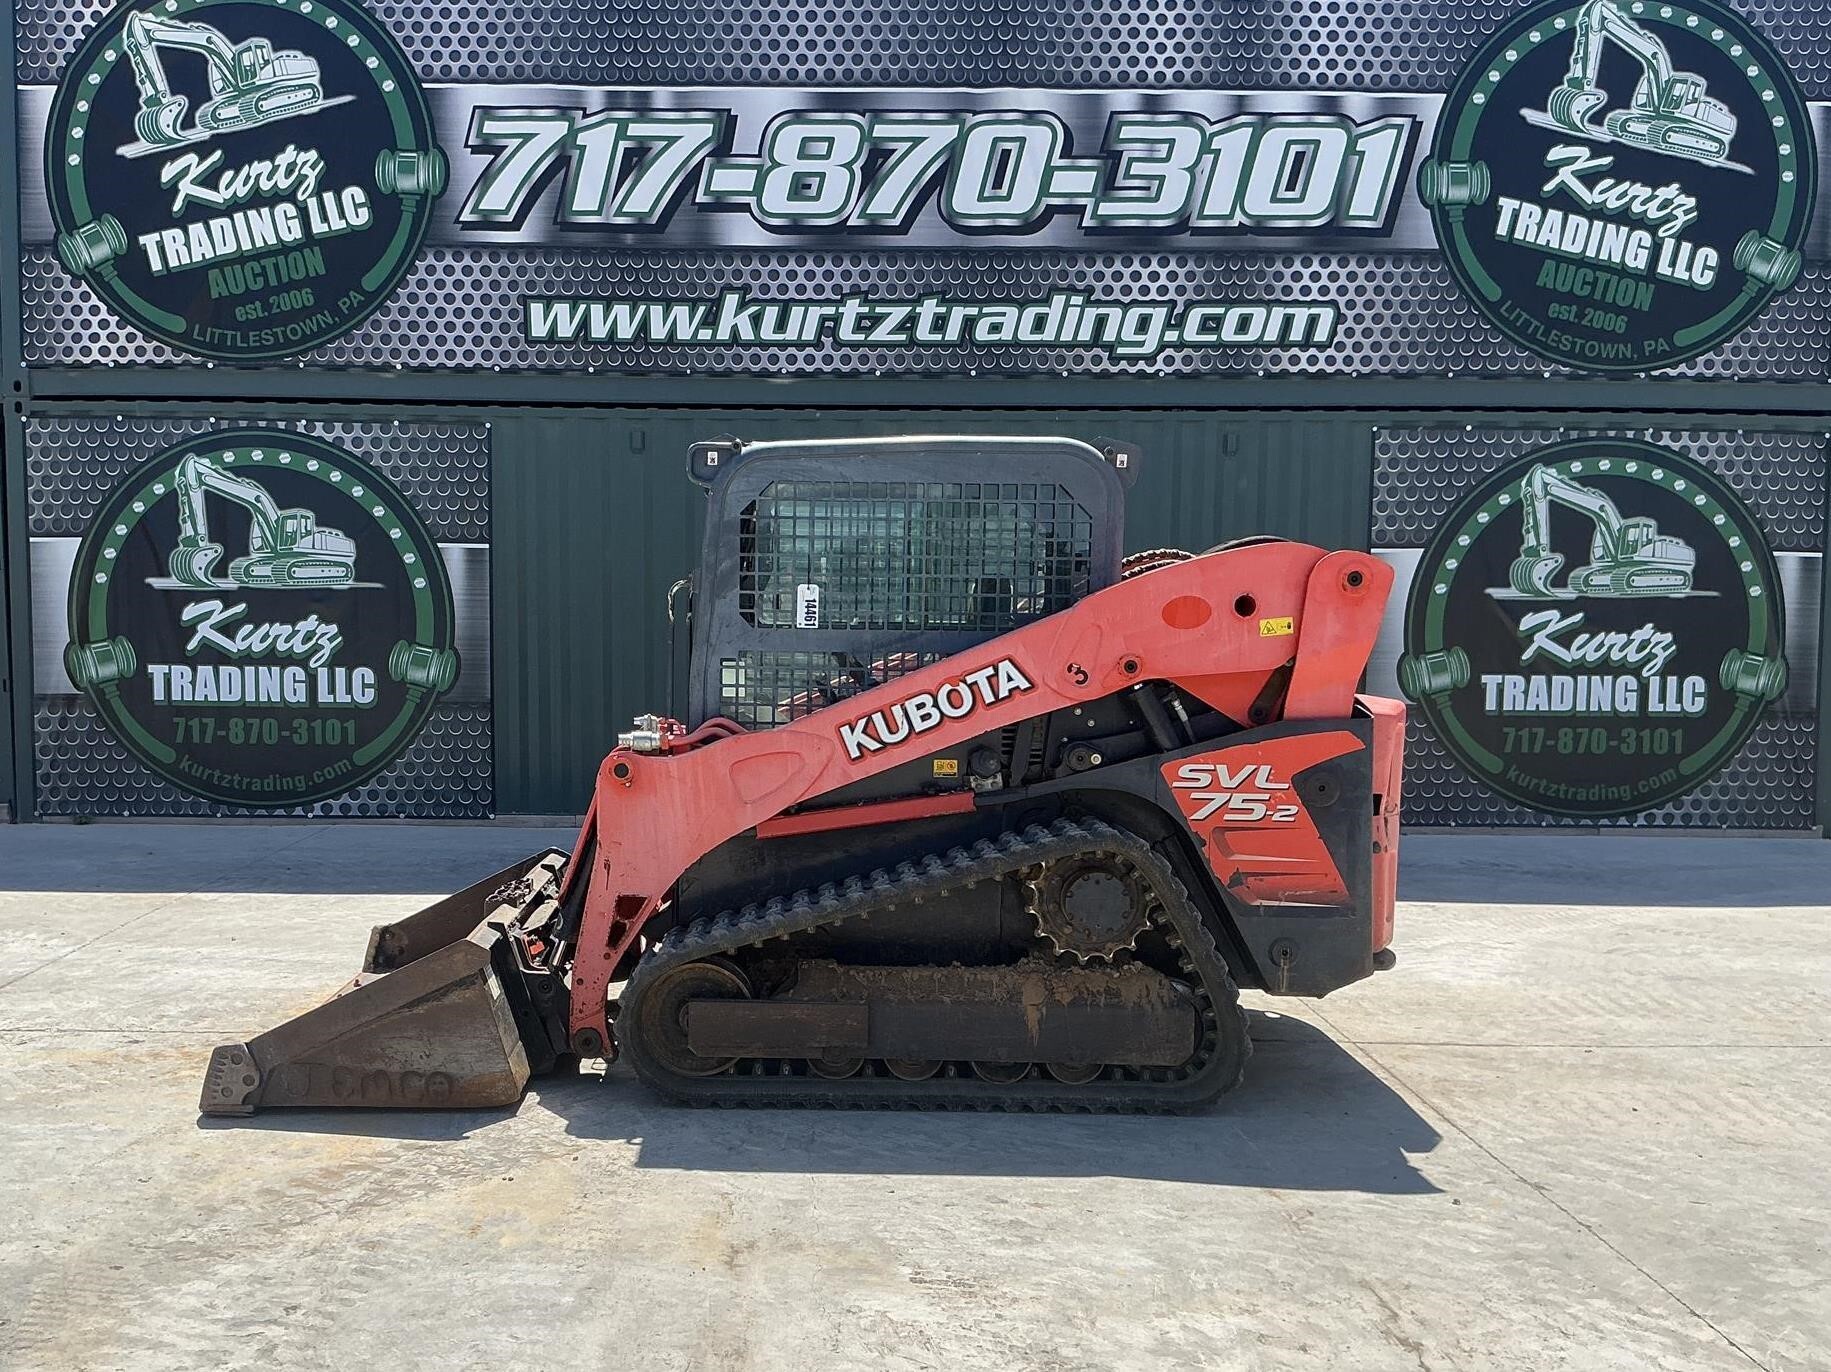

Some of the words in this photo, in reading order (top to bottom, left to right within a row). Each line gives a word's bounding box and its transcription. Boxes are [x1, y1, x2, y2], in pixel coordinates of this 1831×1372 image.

[162, 145, 324, 213] Kurtz
[466, 113, 1408, 222] 717-870-3101
[1541, 145, 1698, 237] Kurtz
[139, 205, 301, 272] TRADING
[306, 187, 371, 235] LLC
[1496, 197, 1651, 269] TRADING
[1659, 239, 1719, 285] LLC
[209, 252, 326, 299] AUCTION
[1537, 260, 1655, 311] AUCTION
[194, 313, 340, 346] LITTLESTOWN,
[339, 291, 366, 318] PA
[235, 302, 268, 322] est.
[271, 288, 315, 316] 2006
[526, 293, 1338, 355] www.kurtztrading.com
[1548, 303, 1578, 324] est.
[1581, 306, 1628, 333] 2006
[1500, 300, 1637, 360] LITTLESTOWN,
[1644, 339, 1670, 355] PA
[181, 600, 343, 668] Kurtz
[804, 599, 817, 626] 14461
[1519, 610, 1676, 677] Kurtz
[148, 665, 307, 702] TRADING
[317, 667, 376, 704] LLC
[1481, 675, 1637, 712] TRADING
[1648, 676, 1705, 711] LLC
[173, 716, 357, 745] 717-870-3101
[838, 659, 1033, 760] KUBOTA
[1503, 727, 1684, 755] 717-870-3101
[180, 756, 351, 791] kurtztrading.com
[1172, 763, 1290, 789] SVL
[1507, 765, 1677, 800] kurtztrading.com
[1188, 792, 1299, 822] 75-2
